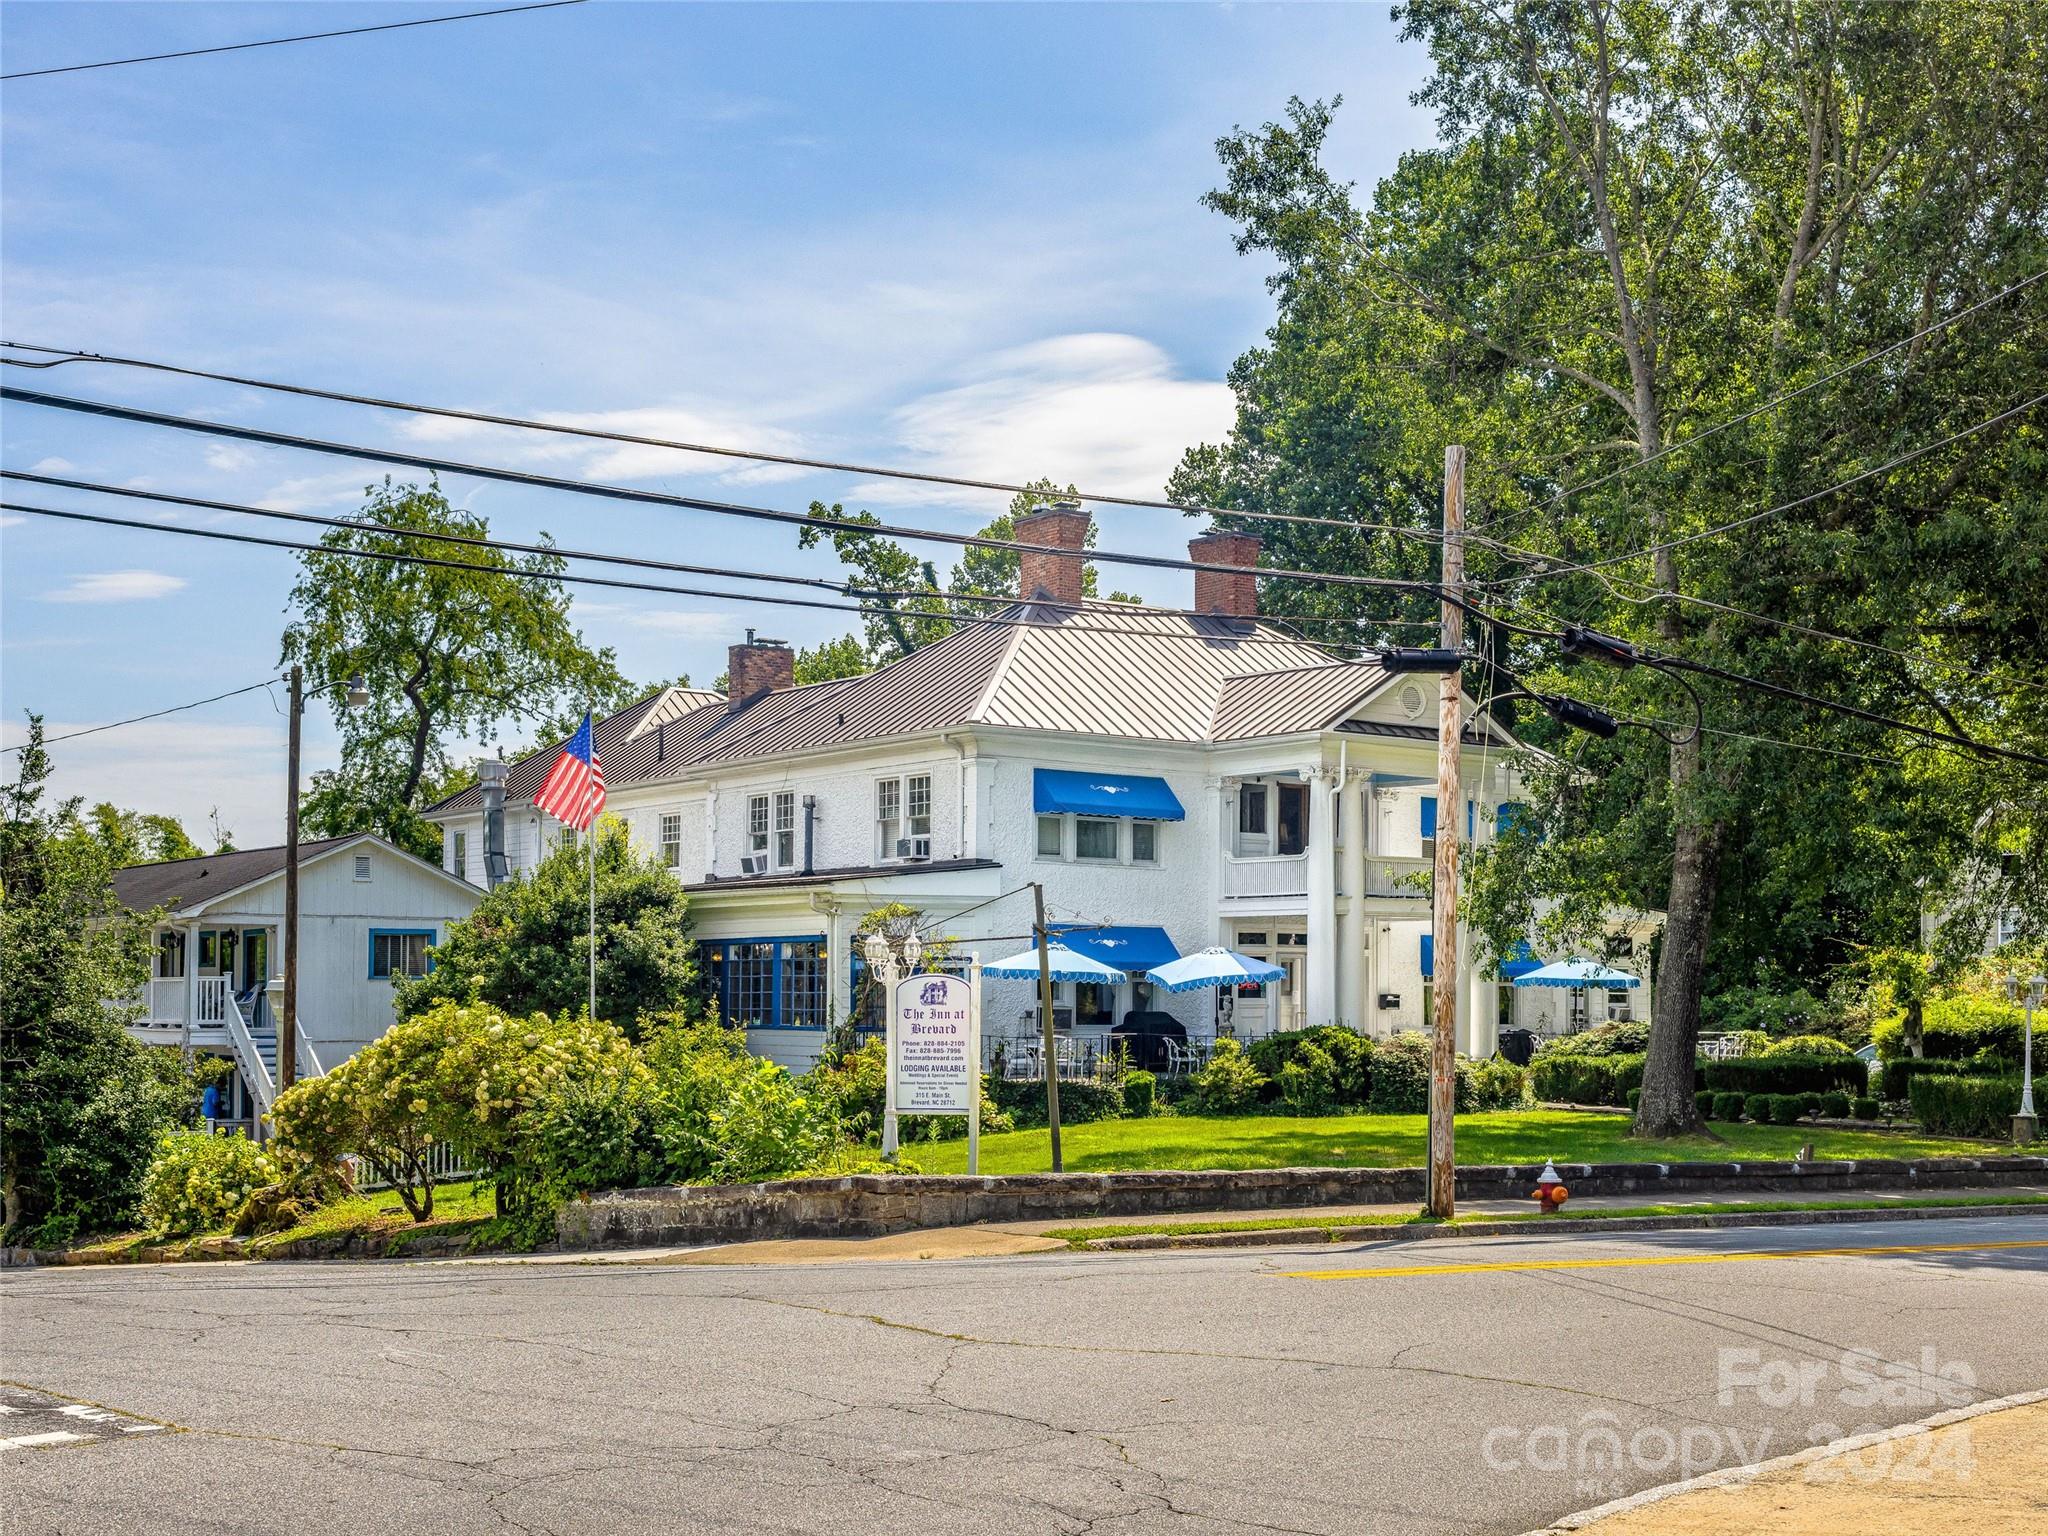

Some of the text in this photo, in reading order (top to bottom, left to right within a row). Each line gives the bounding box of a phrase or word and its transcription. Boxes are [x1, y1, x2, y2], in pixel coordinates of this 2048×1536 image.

[903, 1008, 964, 1020] The Inn at
[911, 1023, 956, 1034] Brevard
